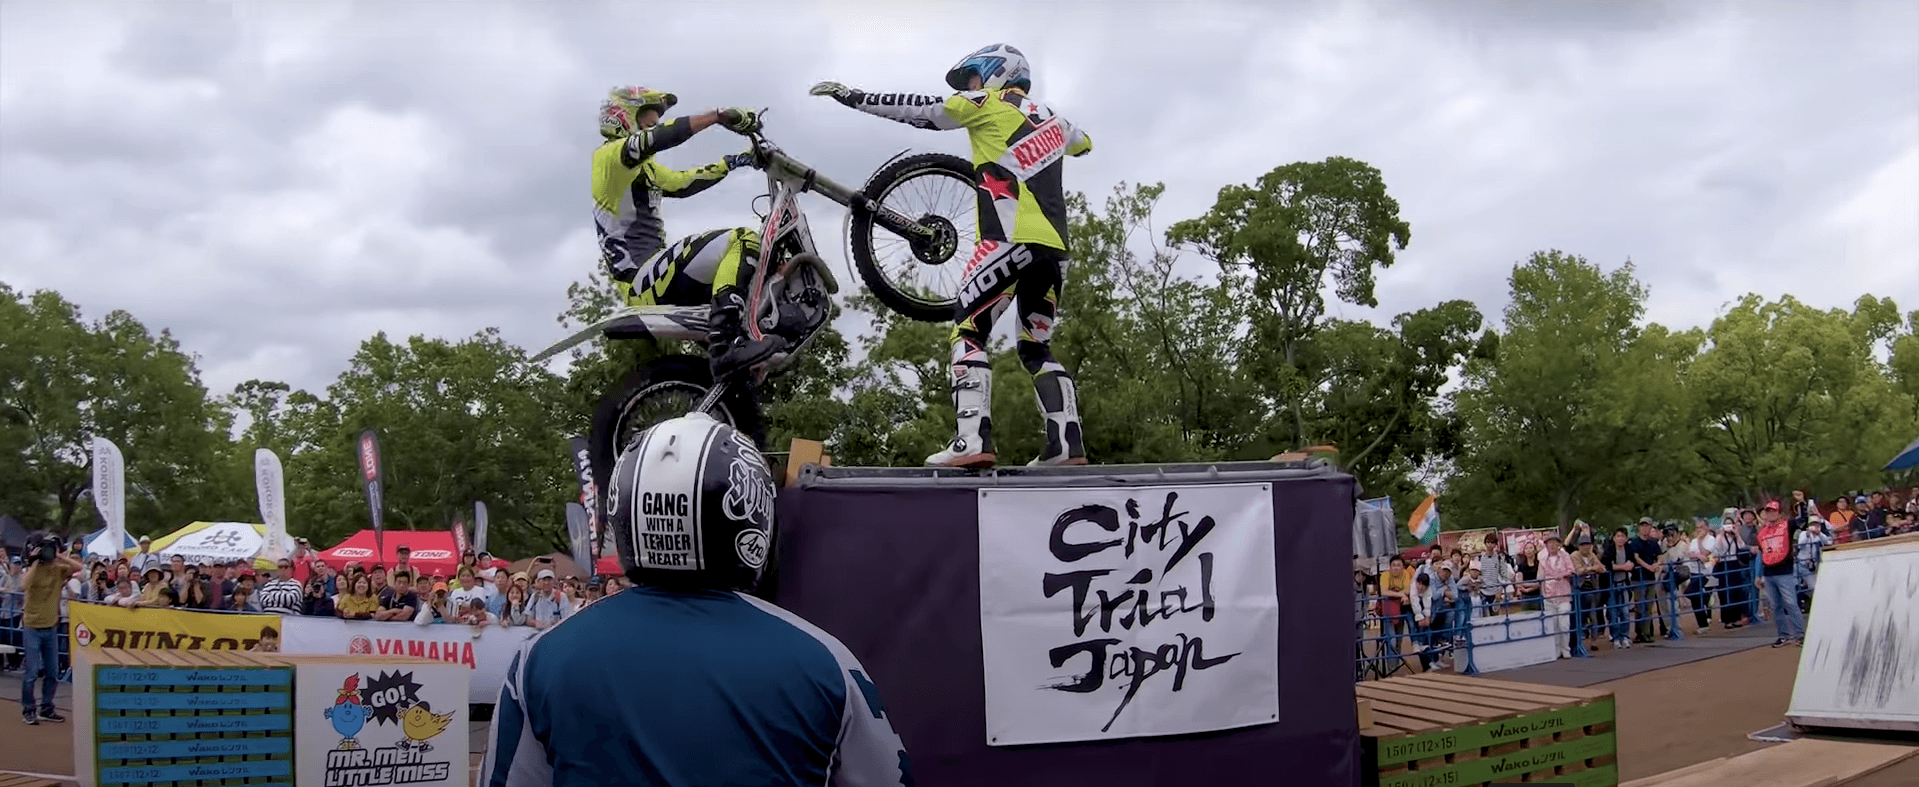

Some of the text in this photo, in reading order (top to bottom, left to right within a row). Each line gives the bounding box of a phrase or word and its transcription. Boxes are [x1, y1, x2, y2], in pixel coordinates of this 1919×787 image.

[1012, 124, 1064, 170] AZZURR
[960, 244, 1033, 309] MOTS
[643, 492, 688, 516] GANG
[646, 517, 684, 532] WITH A
[642, 533, 691, 551] TENDER
[1050, 492, 1215, 586] City
[648, 551, 688, 566] HEART
[1043, 552, 1215, 637] Trial
[1035, 633, 1242, 733] Japan
[371, 684, 407, 708] GO!
[1490, 724, 1529, 739] Wako
[327, 749, 372, 769] MR.
[1491, 758, 1530, 774] Wako
[325, 762, 450, 787] LITTLE MISS
